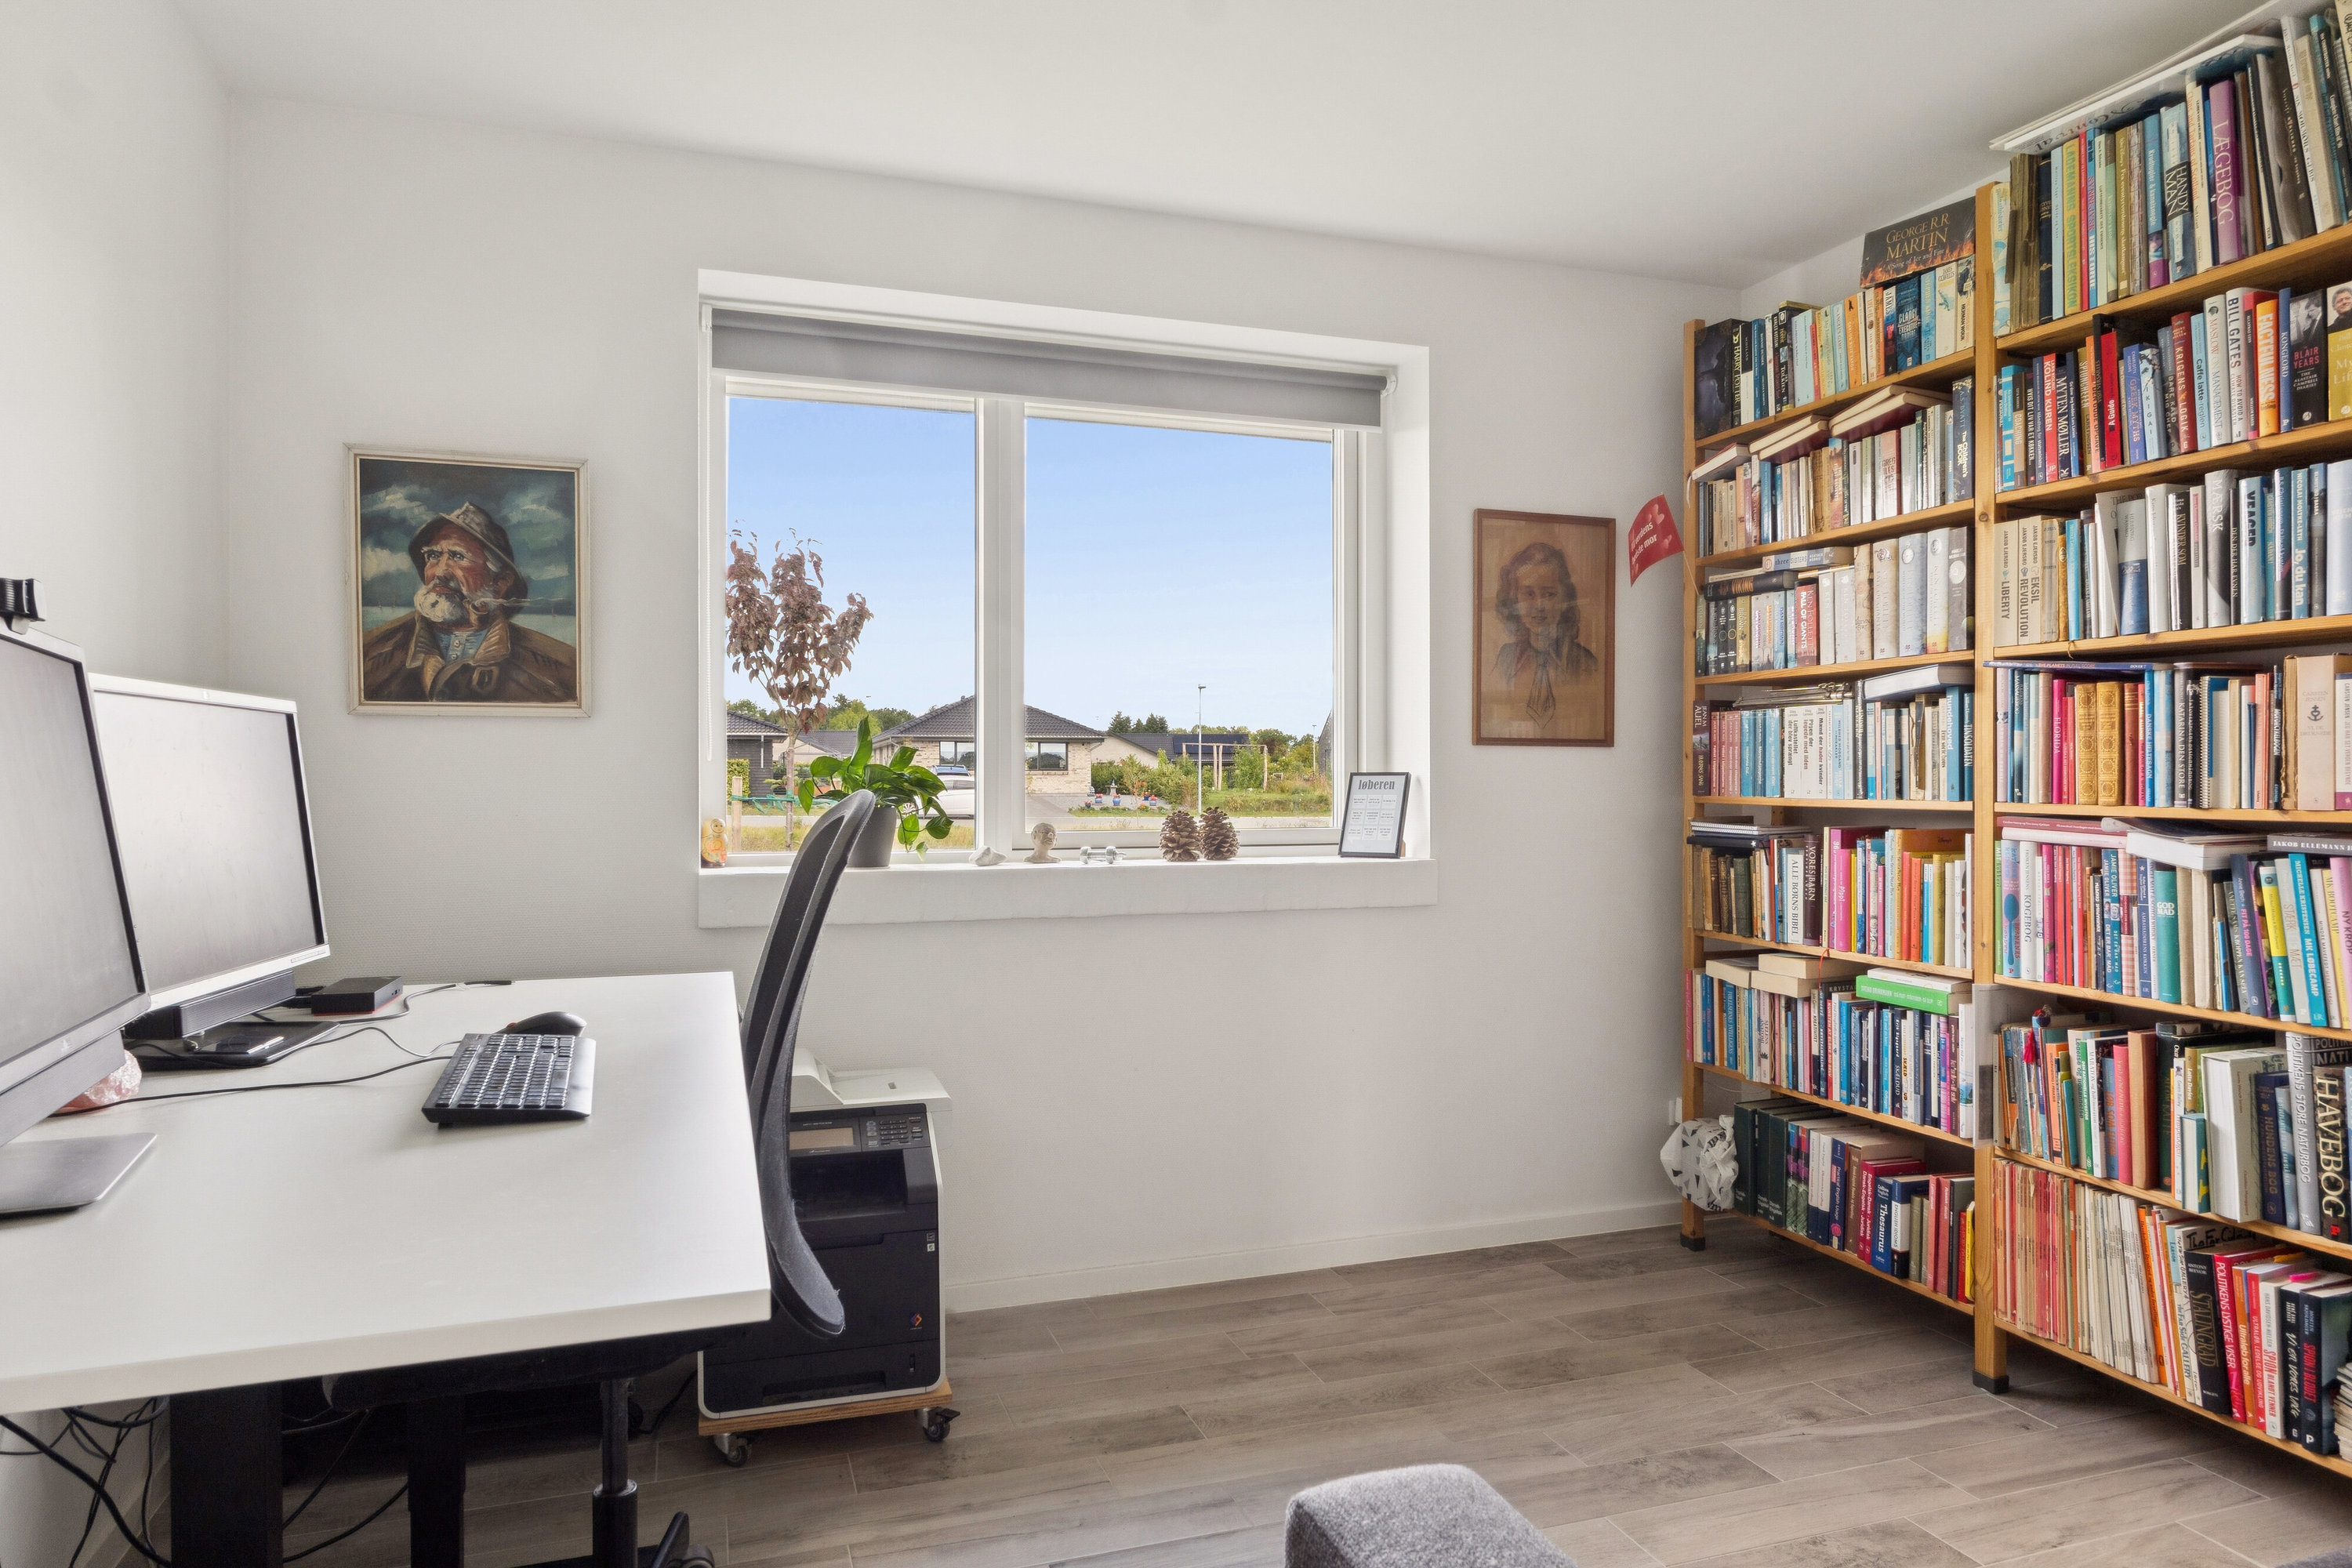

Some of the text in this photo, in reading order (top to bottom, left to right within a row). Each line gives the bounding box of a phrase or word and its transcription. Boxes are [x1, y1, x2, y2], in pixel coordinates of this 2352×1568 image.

[2165, 169, 2177, 217] MAN
[2176, 165, 2189, 212] HANDY
[2212, 121, 2234, 226] LÆGEBOG
[1886, 227, 1948, 261] MARTIN
[2209, 318, 2220, 354] MASLOW
[2227, 297, 2241, 368] BILL GATES
[2294, 347, 2319, 361] BLAIR
[2293, 356, 2320, 368] YEARS
[2129, 379, 2140, 442] GREEK MYTHS
[2175, 347, 2188, 432] KRIGENS LOGIK
[2212, 370, 2223, 428] MANAGEMENT
[2014, 414, 2023, 445] COACHING
[2056, 377, 2069, 456] MYTEN MØLLER
[1882, 457, 1896, 466] GREG
[2212, 479, 2223, 532] MÆRSK
[1644, 533, 1657, 548] mor
[1791, 555, 1807, 564] SISTERS
[2176, 514, 2187, 565] KVINDER SOM
[2001, 580, 2009, 619] LIBERTY
[2031, 576, 2039, 604] EKSIL
[2293, 549, 2306, 606] Jo, du kan
[1801, 609, 1806, 619] OF
[2020, 579, 2028, 637] REVOLUTION
[1964, 724, 1973, 767] TINSOLDATEN
[1358, 779, 1396, 790] løberen
[2241, 920, 2250, 928] PÅ
[2283, 904, 2302, 969] STÆRK MÆT
[2295, 860, 2318, 996] MICHELLE KRISTENSEN MK LØBECAMP
[2342, 911, 2352, 954] NY KROP
[2292, 1035, 2310, 1183] POLITIKENS STORE NATURBOG
[2264, 1116, 2276, 1194] HUNDENS BOG
[2316, 1076, 2345, 1218] HAVEBOG
[1878, 1203, 1887, 1252] Thesaurus
[2190, 1290, 2219, 1368] STALINGRAD
[2216, 1261, 2236, 1368] POLITIKENS LYSTIGE VISER
[2180, 1342, 2191, 1380] GALLERY
[2238, 1324, 2251, 1385] Ultraløb for alle
[2263, 1350, 2277, 1374] SPION
[2267, 1374, 2275, 1396] BLANDT
